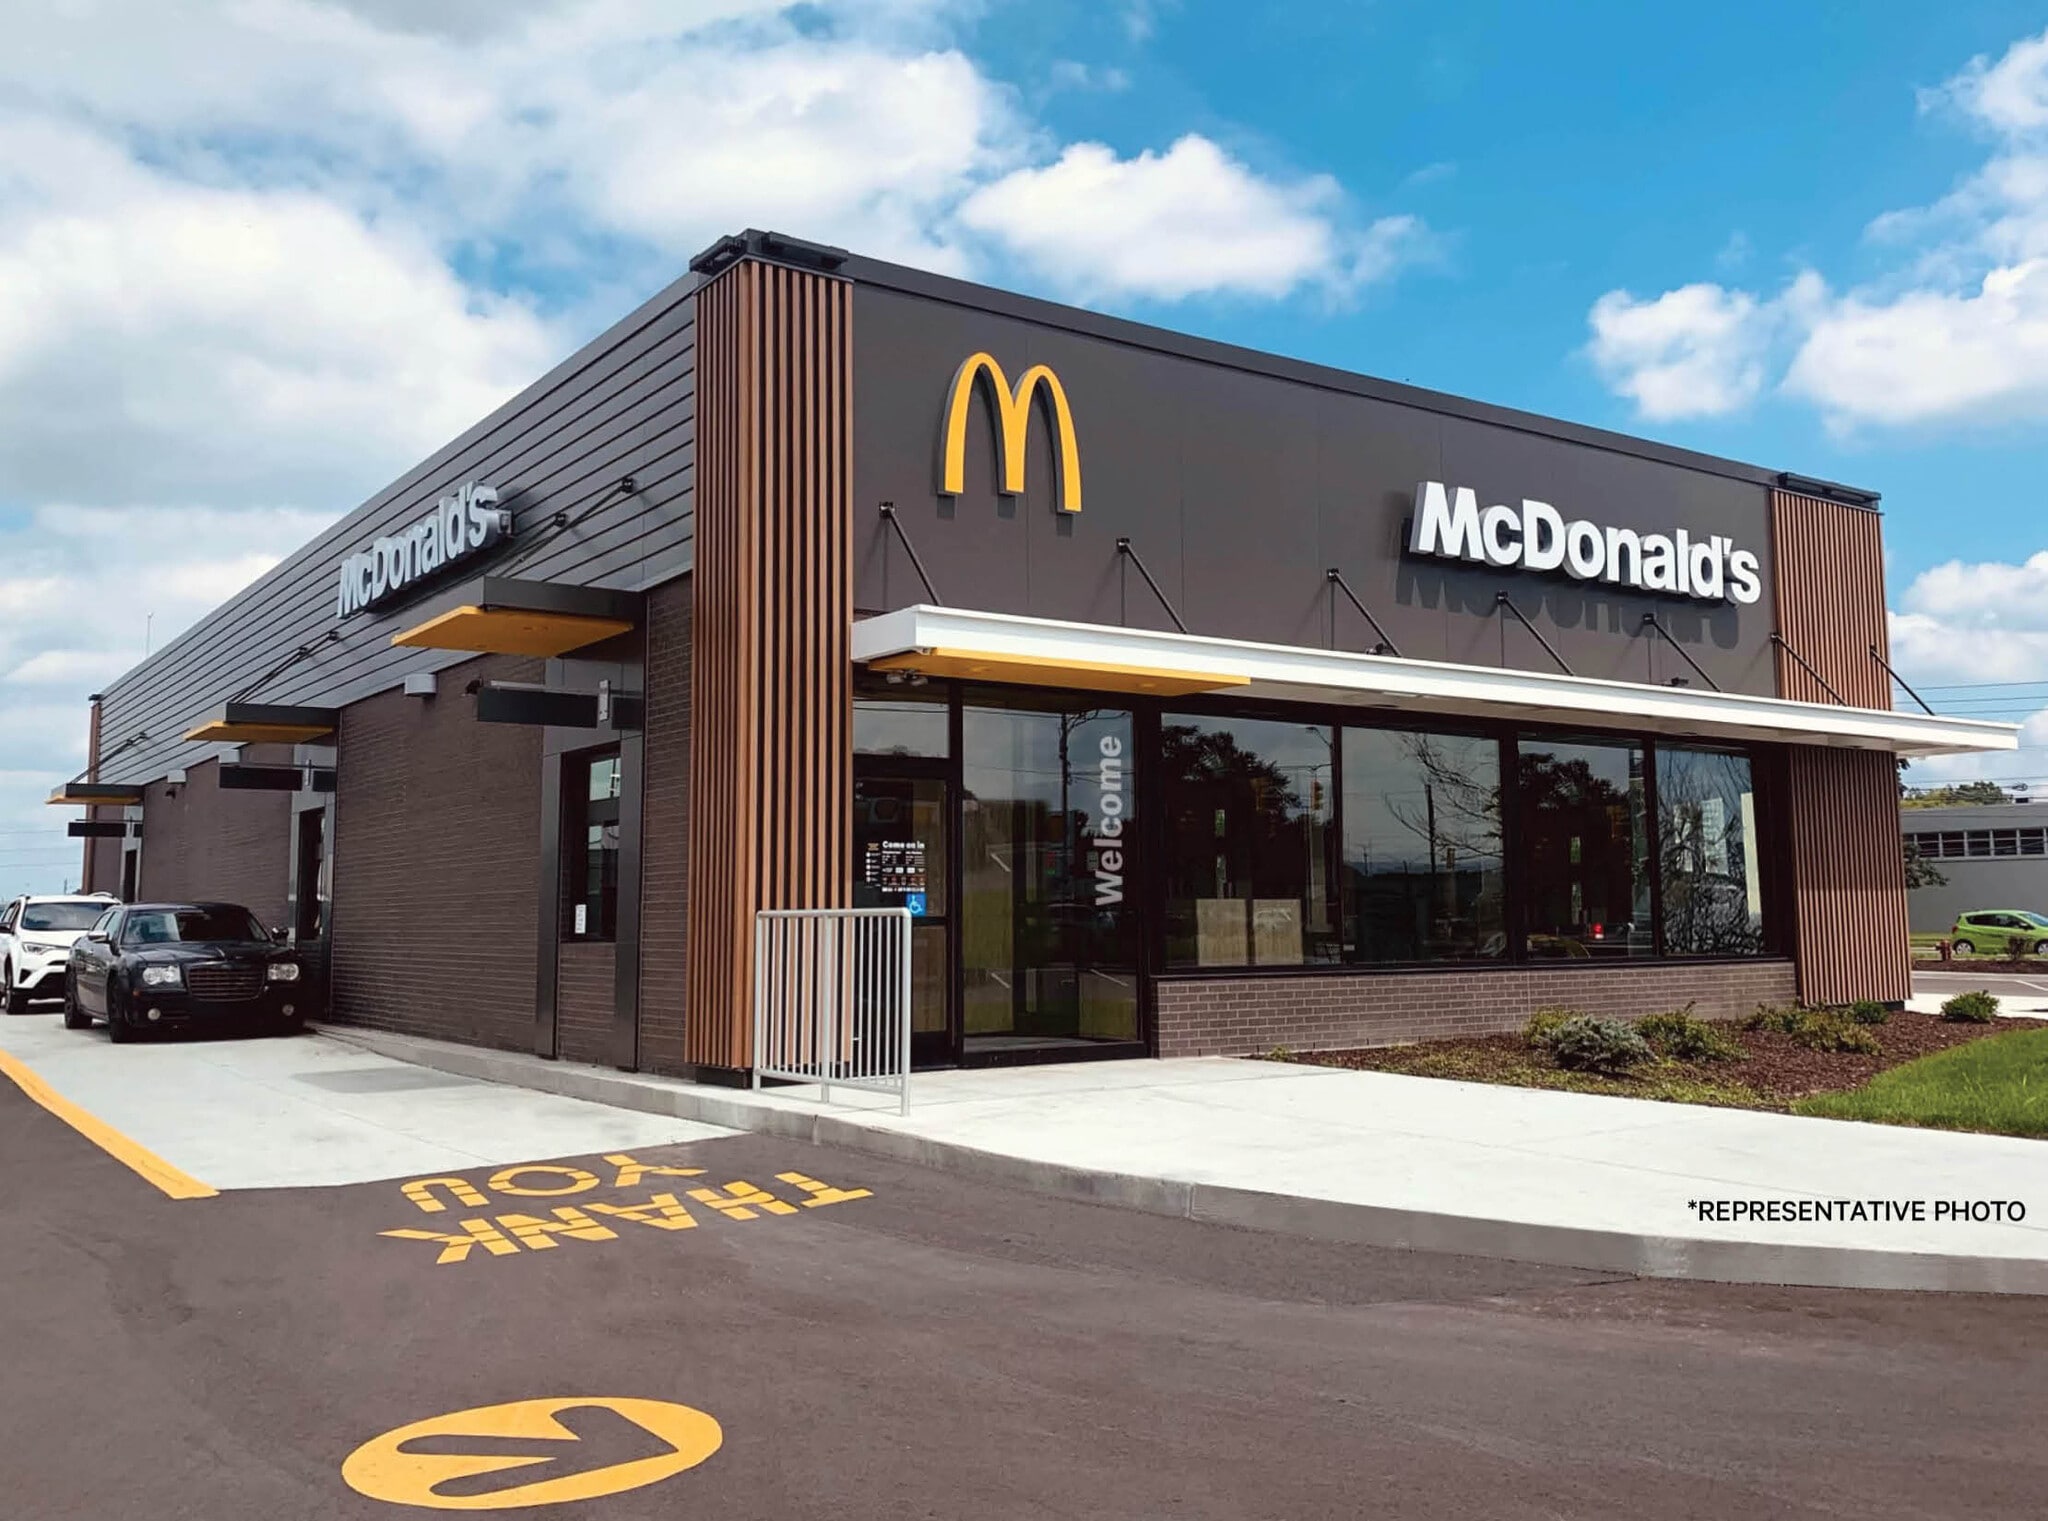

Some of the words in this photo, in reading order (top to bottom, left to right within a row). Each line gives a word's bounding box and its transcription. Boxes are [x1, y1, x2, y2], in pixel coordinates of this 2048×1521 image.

[337, 481, 498, 619] McDonald's
[1409, 480, 1762, 605] McDonald's
[1093, 735, 1124, 906] Welcome
[376, 1171, 874, 1265] THANK
[400, 1154, 708, 1214] YOU
